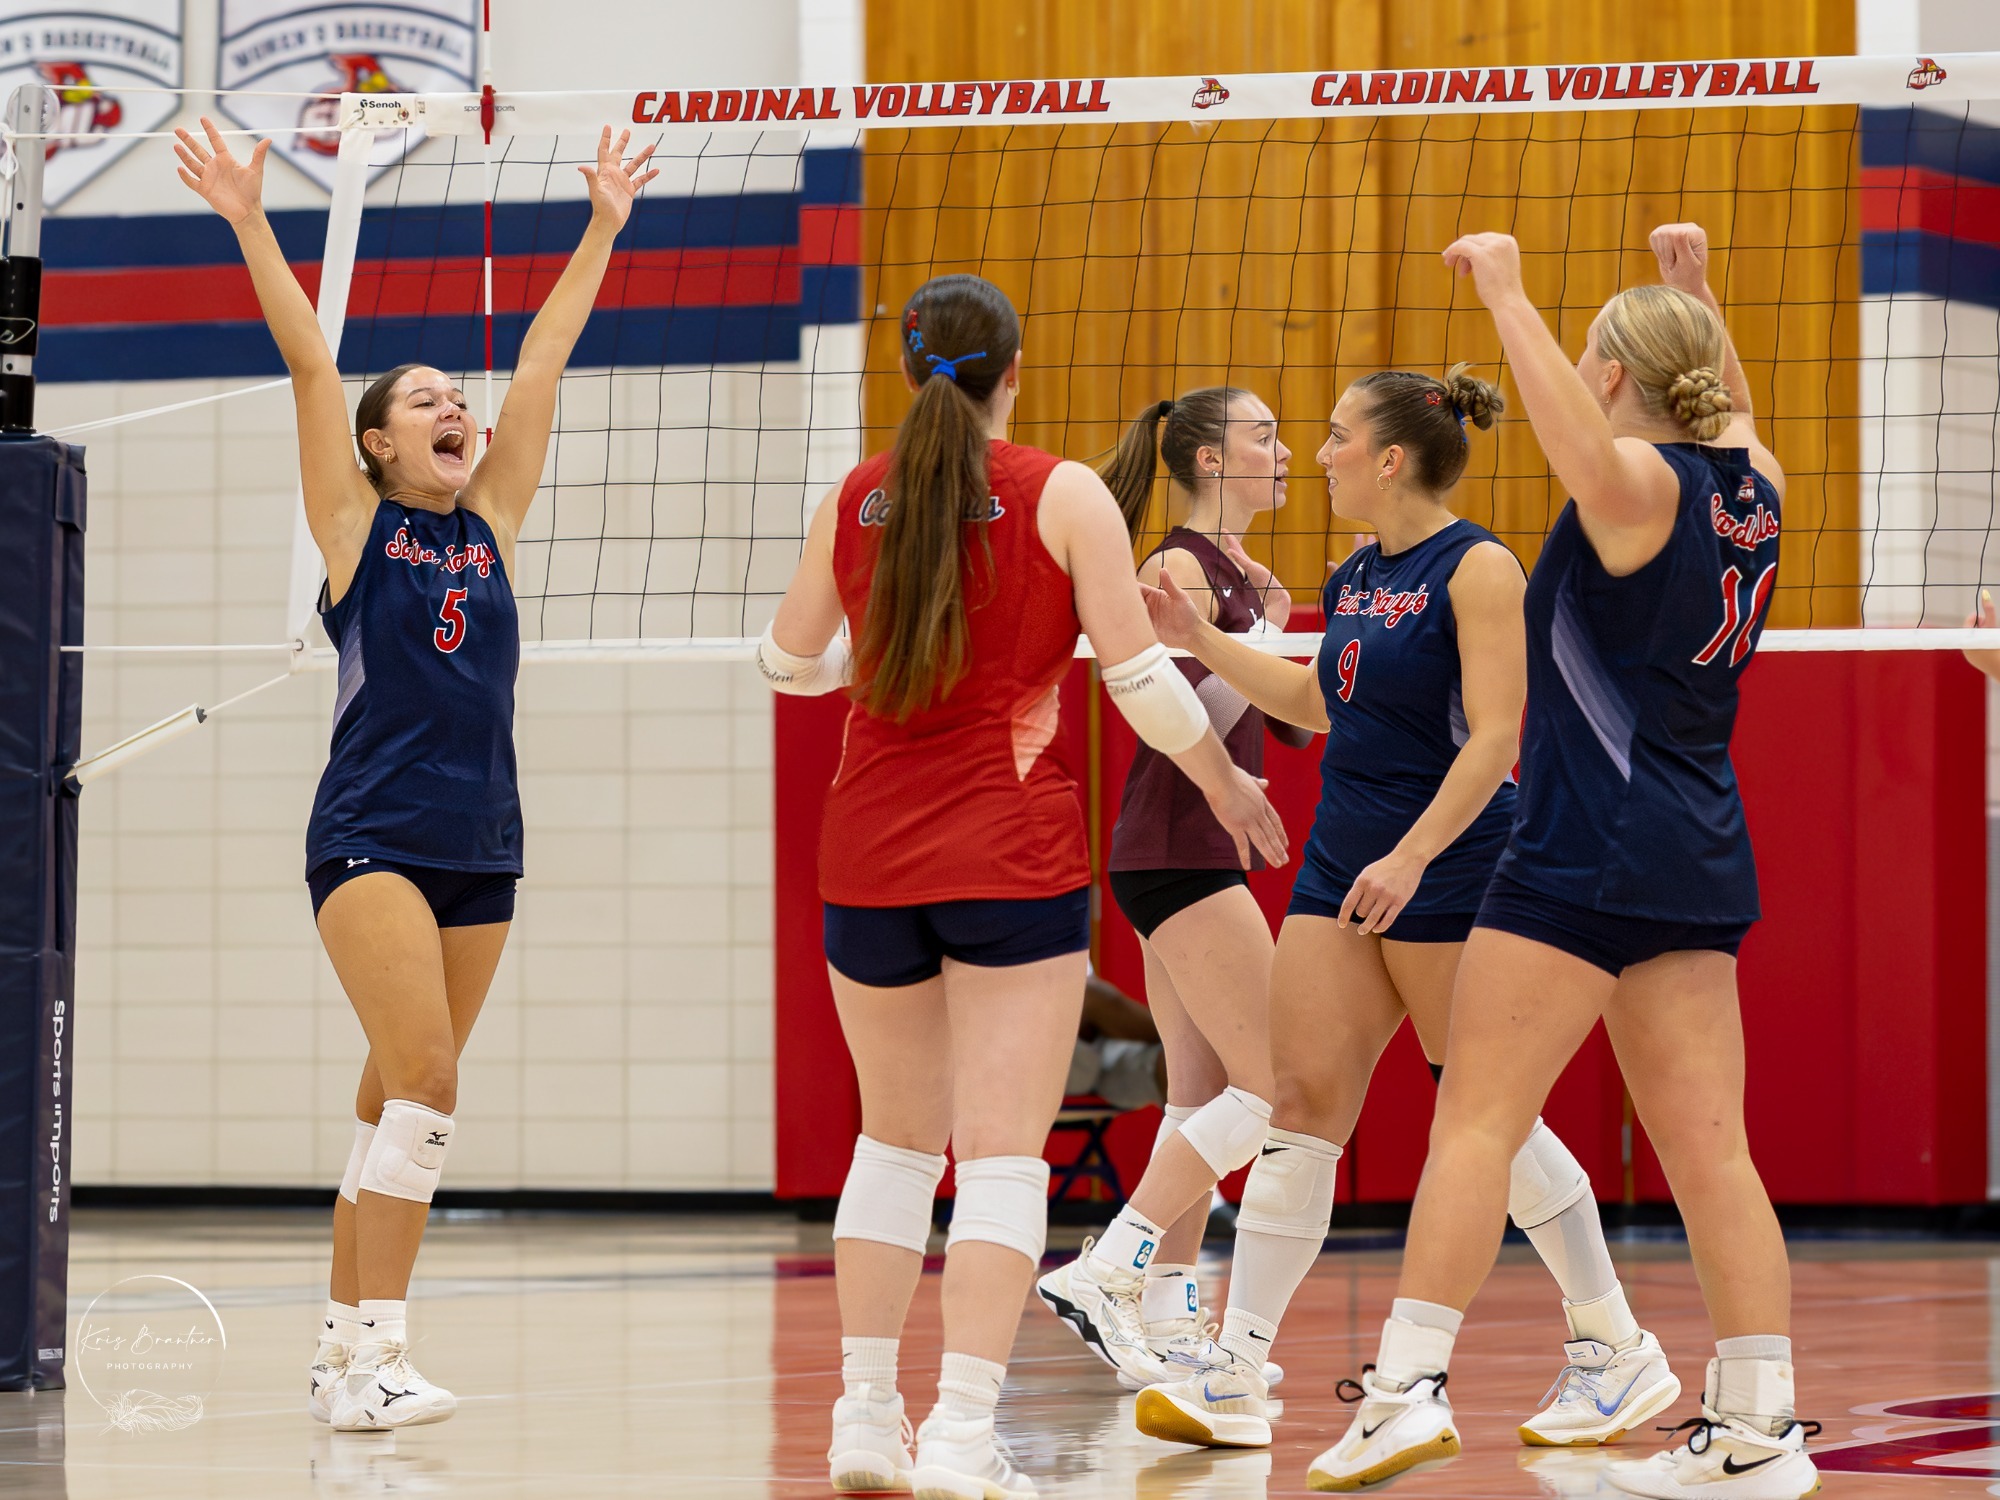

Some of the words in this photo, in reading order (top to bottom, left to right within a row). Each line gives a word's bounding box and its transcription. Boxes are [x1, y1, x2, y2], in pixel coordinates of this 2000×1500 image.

[43, 30, 172, 69] BASKETBALL
[231, 25, 326, 69] WOMEN'S
[336, 21, 465, 60] BASKETBALL
[368, 100, 402, 110] Senoh
[631, 86, 843, 125] CARDINAL
[852, 79, 1112, 119] VOLLEYBALL
[1310, 67, 1535, 107] CARDINAL
[1545, 59, 1821, 102] VOLLEYBALL
[433, 587, 469, 654] 5
[1336, 638, 1361, 703] 9
[52, 999, 66, 1098] sports
[49, 1103, 63, 1223] imports
